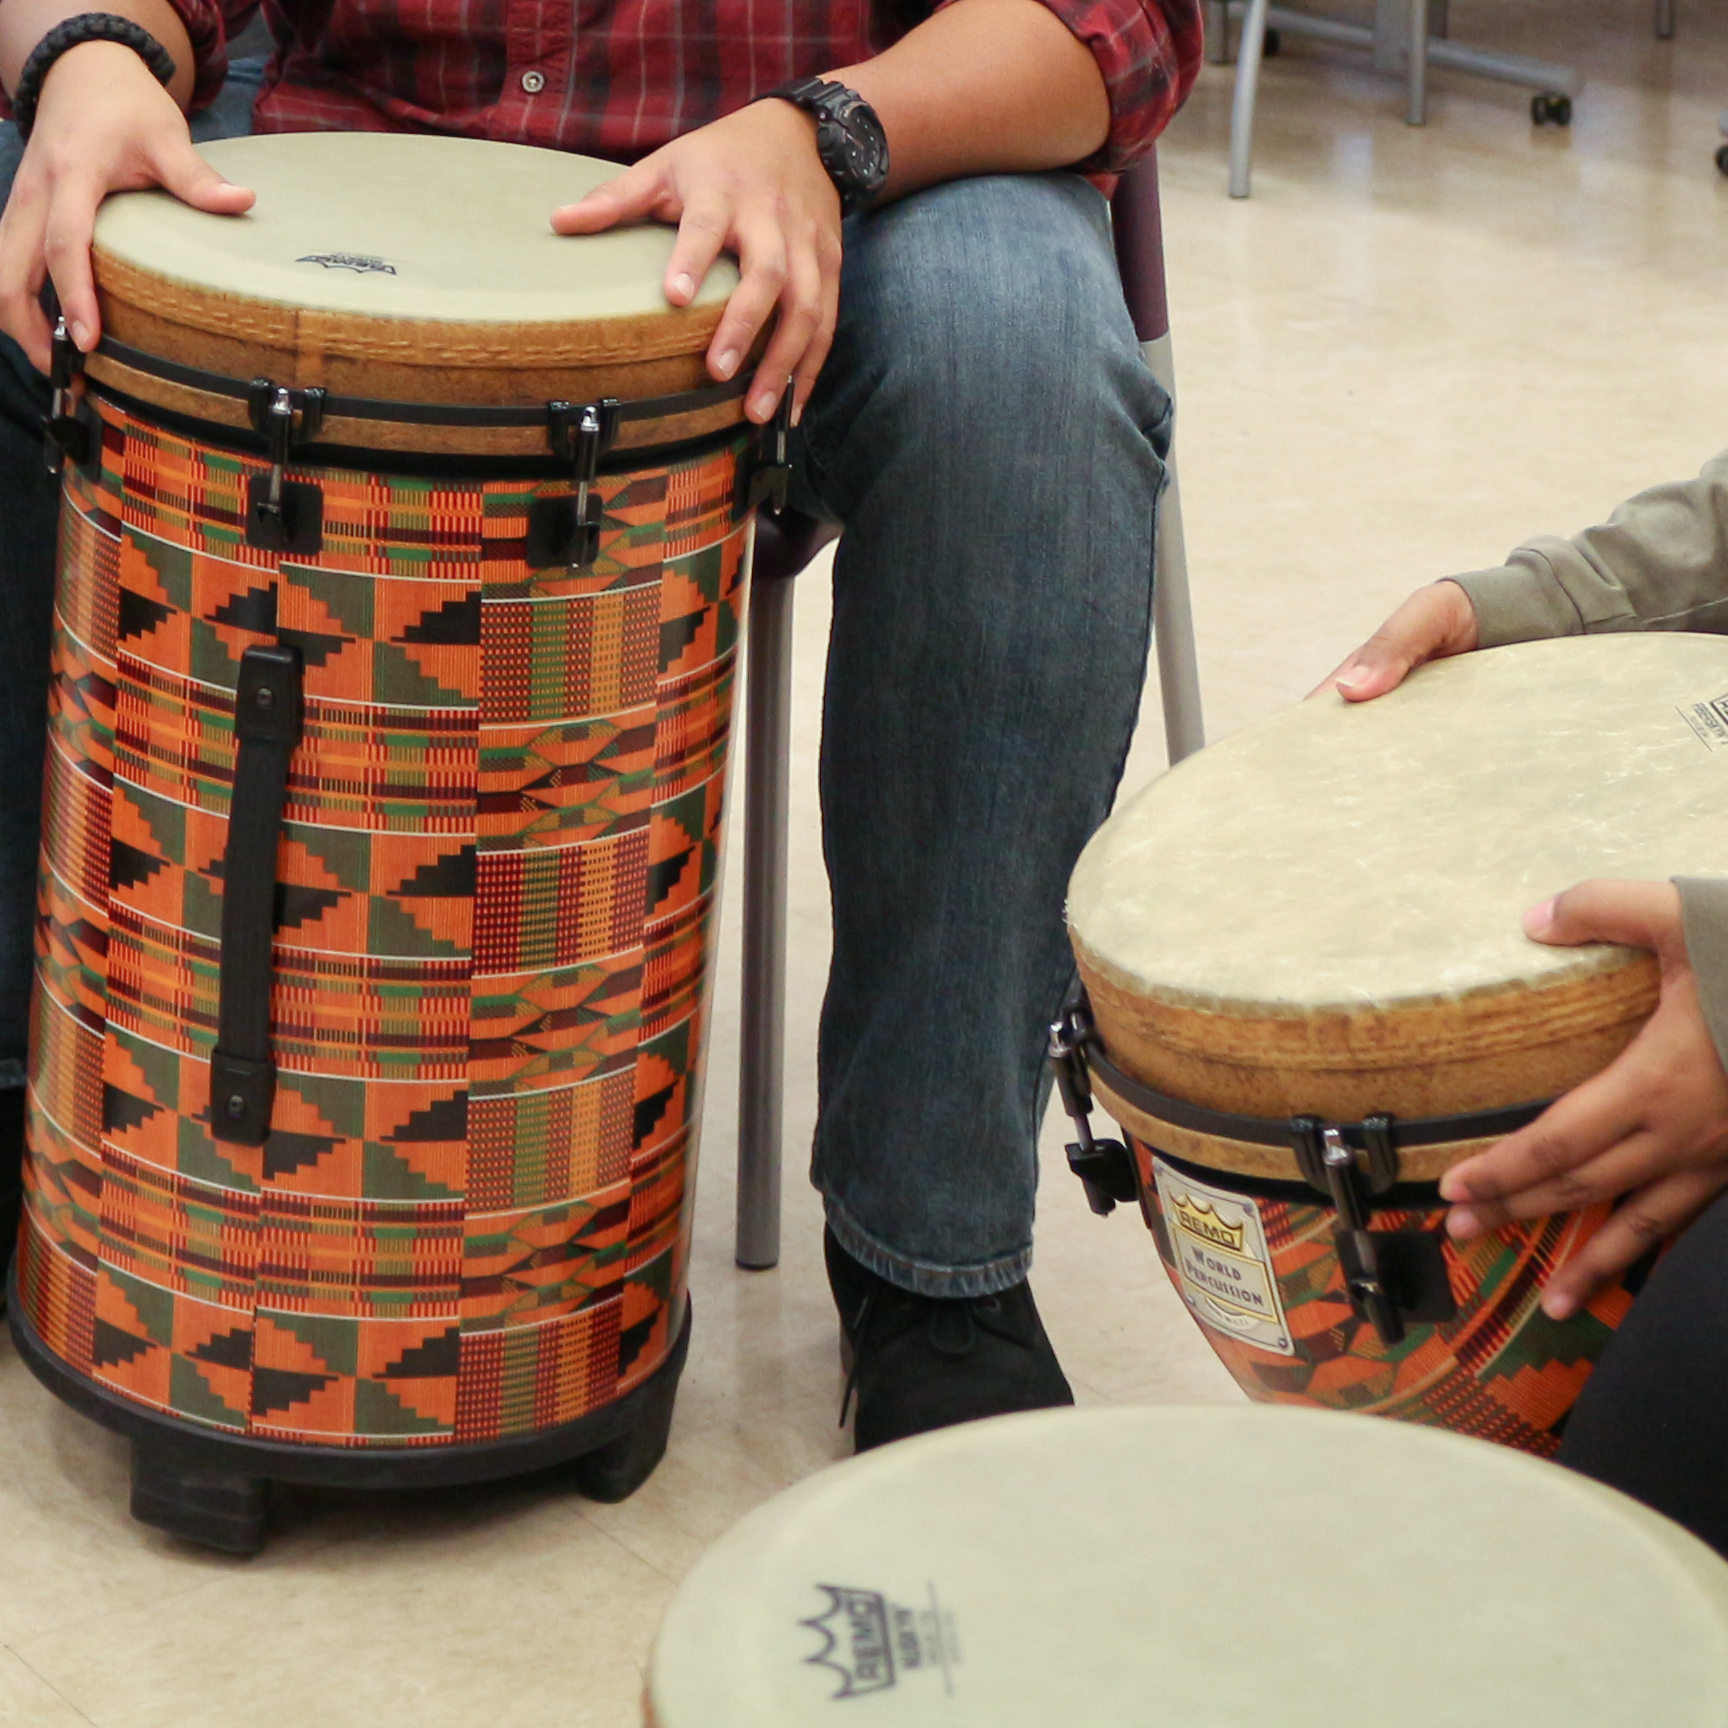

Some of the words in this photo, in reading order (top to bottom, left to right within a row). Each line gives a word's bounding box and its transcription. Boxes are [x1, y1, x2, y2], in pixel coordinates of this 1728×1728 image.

[1179, 1209, 1235, 1245] REMO
[1191, 1245, 1242, 1281] WORLD
[1184, 1256, 1264, 1307] PERCUSSION
